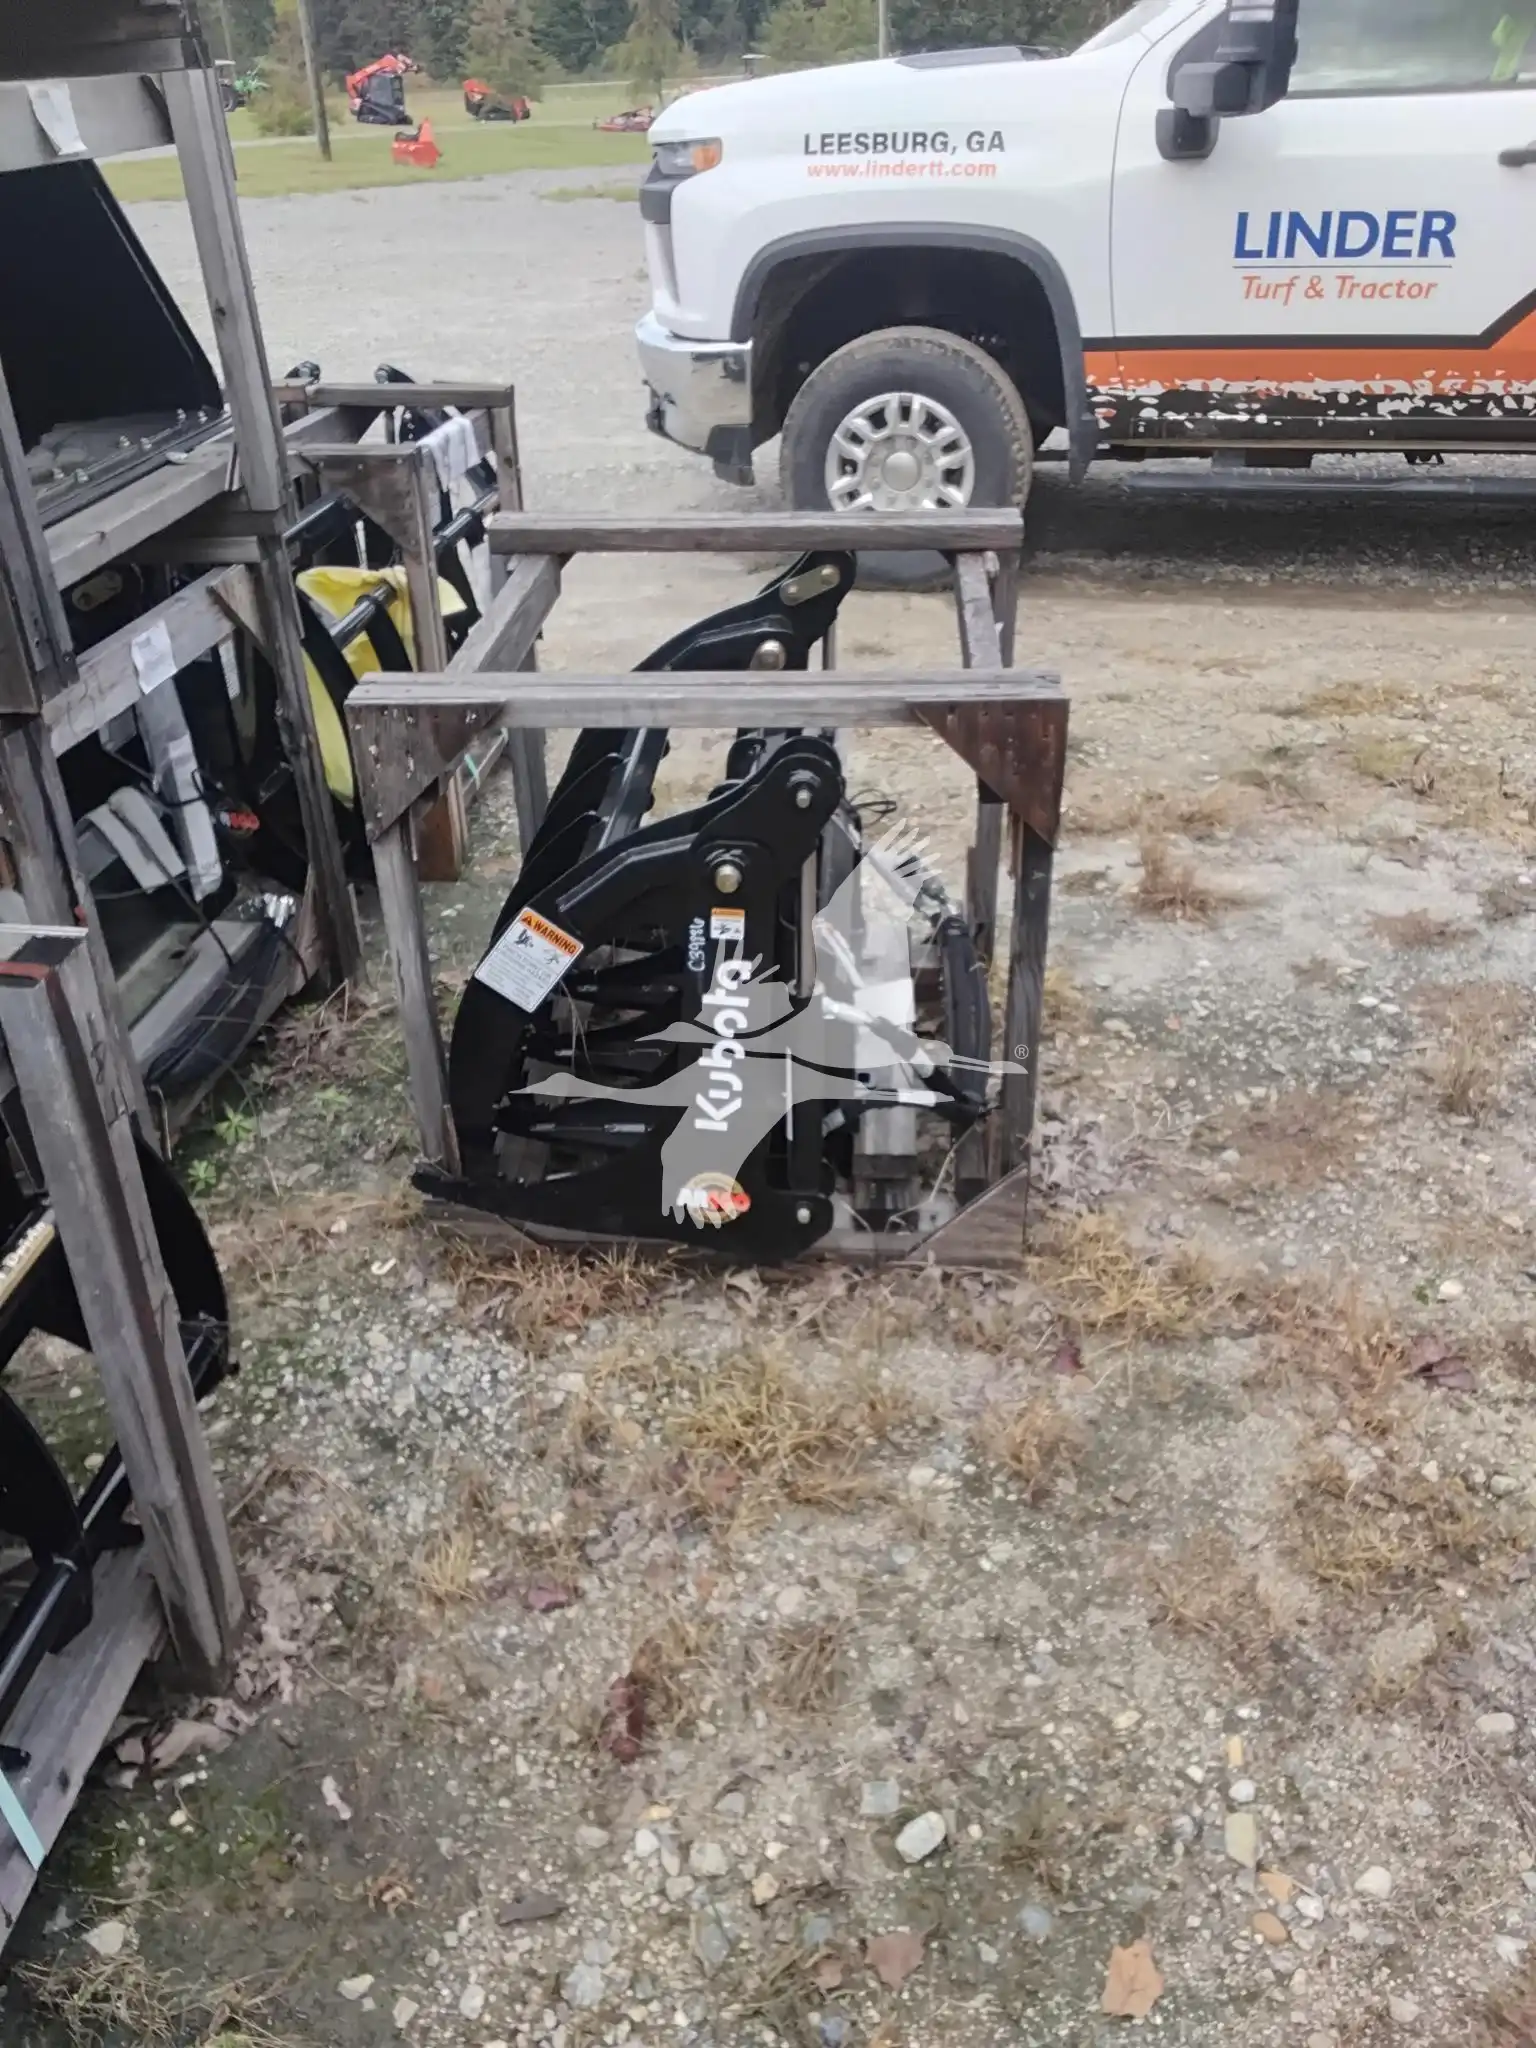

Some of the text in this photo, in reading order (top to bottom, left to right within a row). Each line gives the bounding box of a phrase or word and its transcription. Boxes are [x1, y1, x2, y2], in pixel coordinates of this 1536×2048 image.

[804, 130, 1006, 156] LEESBURG, GA
[807, 159, 998, 178] www.lindertt.com
[1233, 210, 1458, 259] LINDER
[1241, 274, 1439, 307] Turf & Tractor
[533, 918, 578, 956] WARNING
[694, 959, 752, 1132] Kubota
